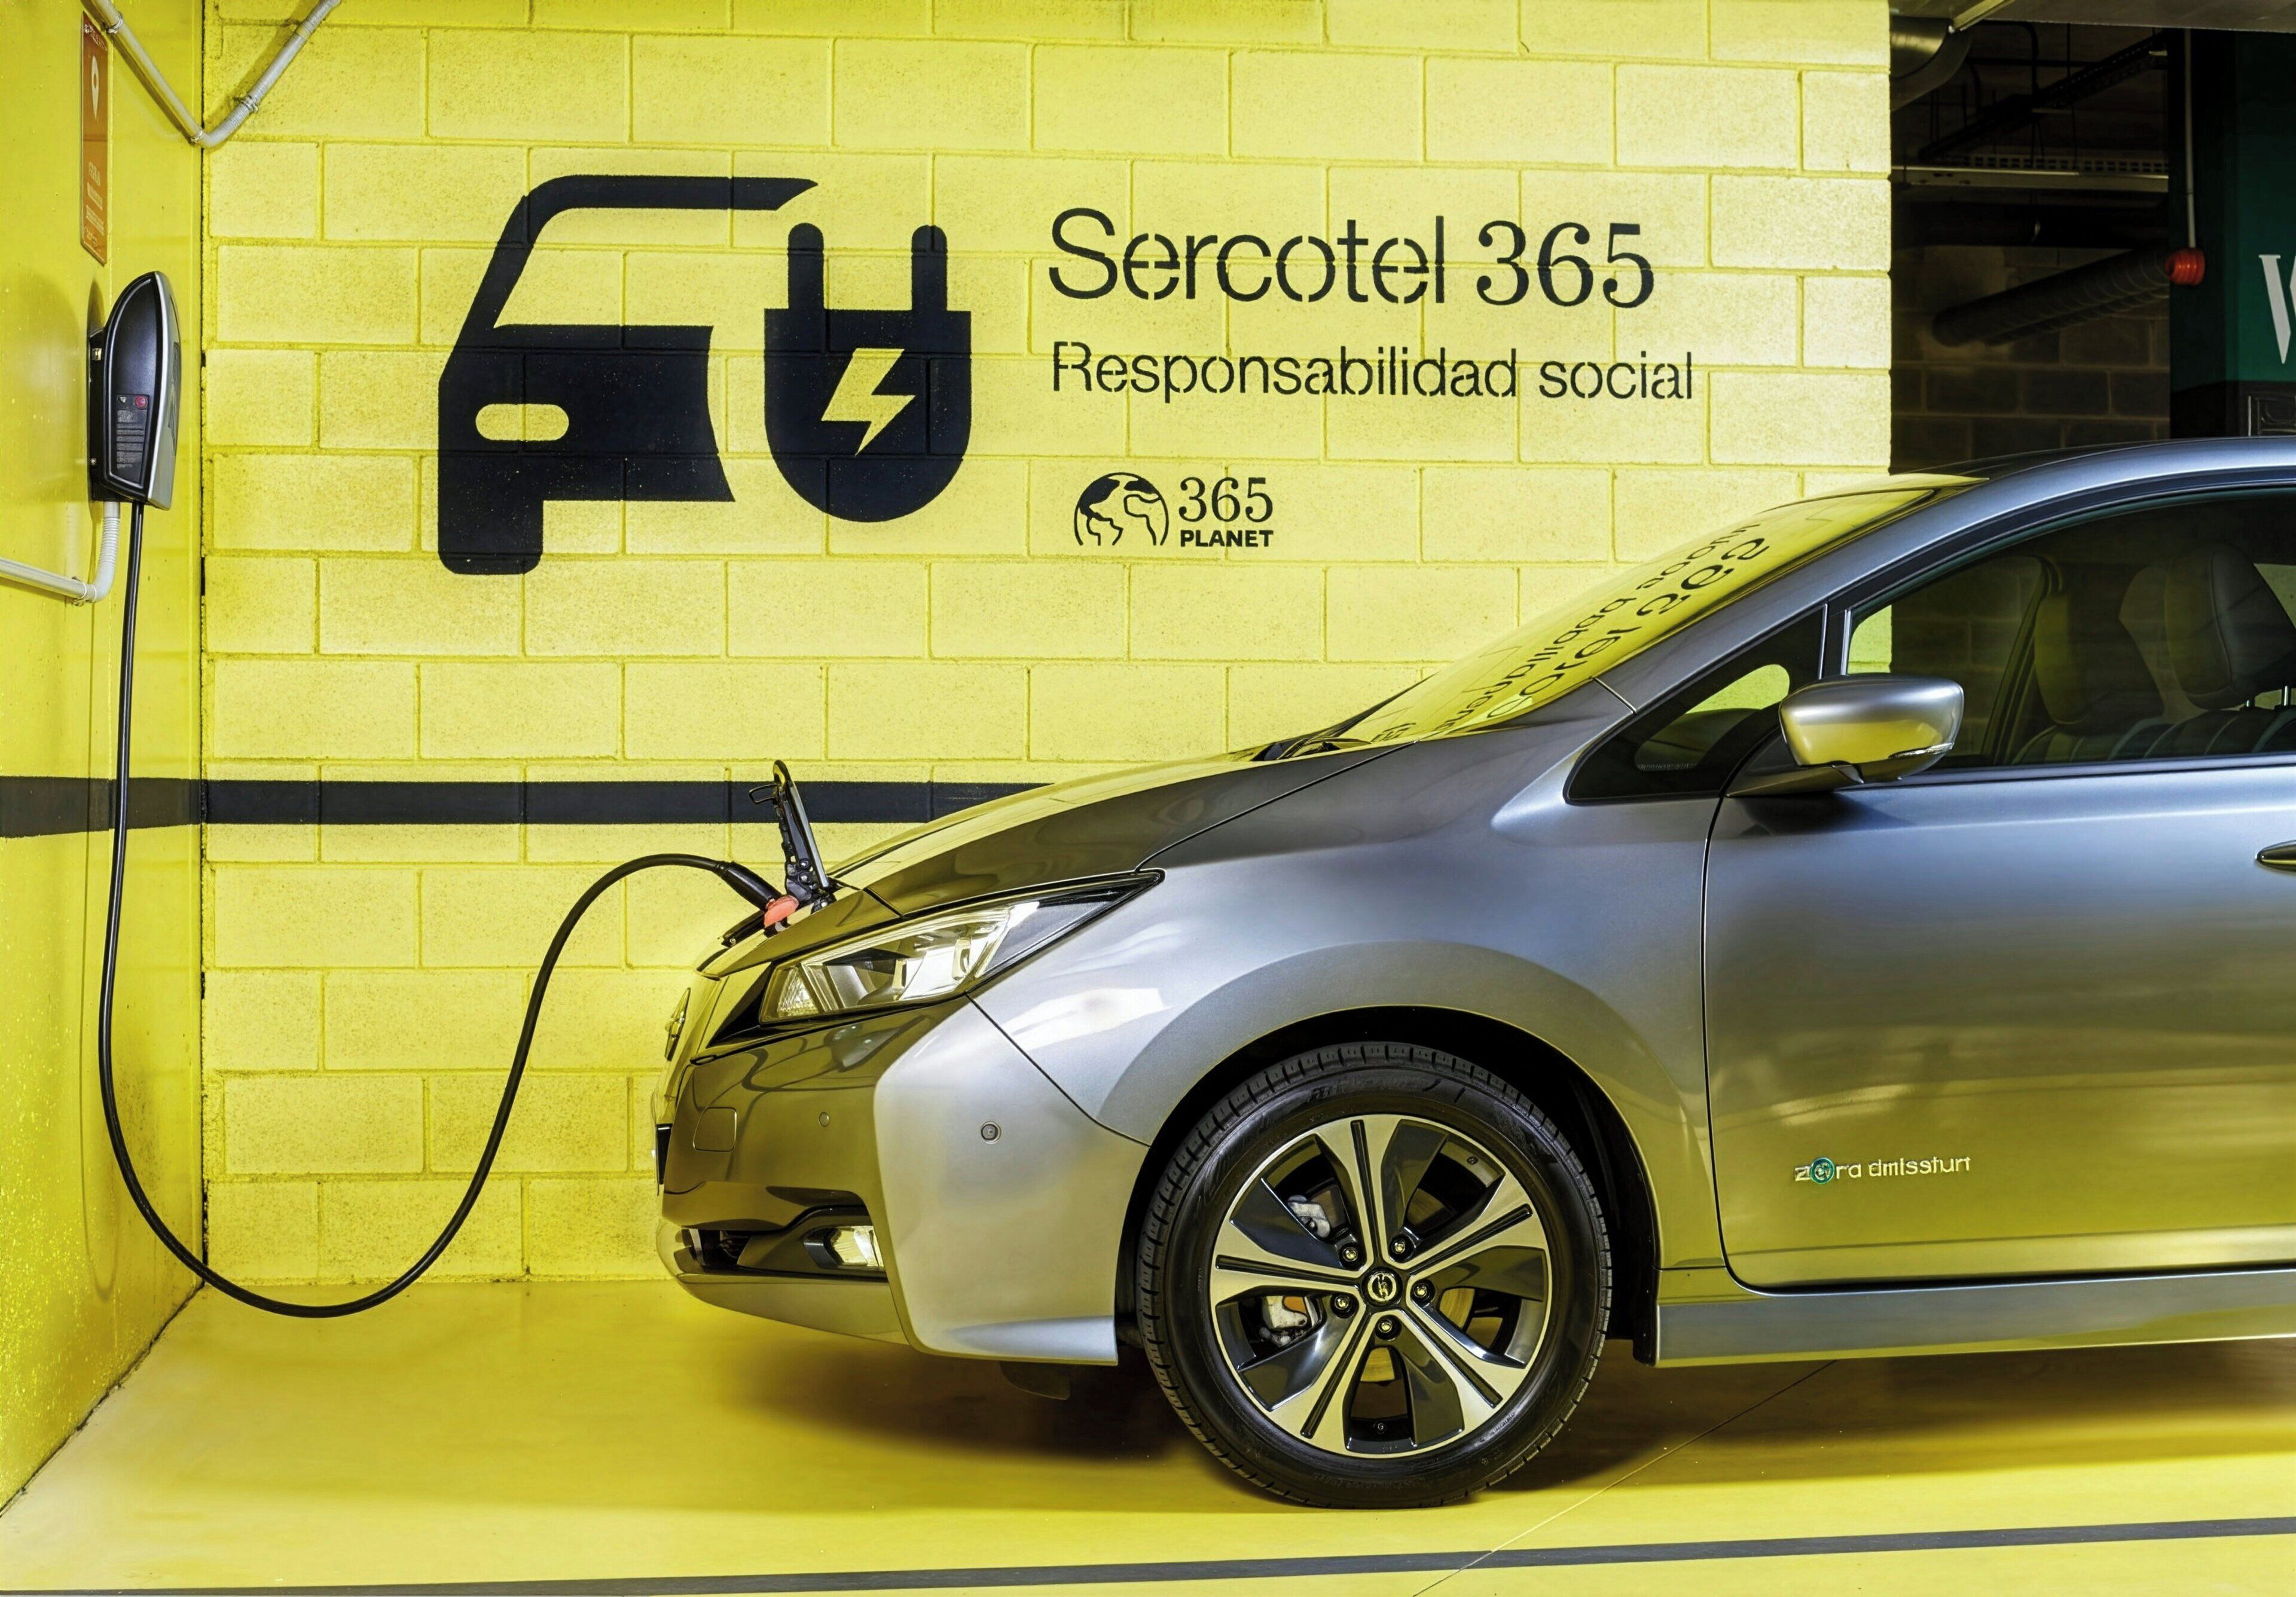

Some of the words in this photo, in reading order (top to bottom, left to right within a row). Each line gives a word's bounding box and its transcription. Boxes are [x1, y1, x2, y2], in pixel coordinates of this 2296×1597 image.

[1049, 207, 1445, 304] Sercotel
[1476, 220, 1654, 309] 365
[1053, 341, 1516, 404] Responsabilidad
[1539, 351, 1692, 399] social
[1178, 477, 1273, 523] 365
[1180, 530, 1274, 547] PLANET
